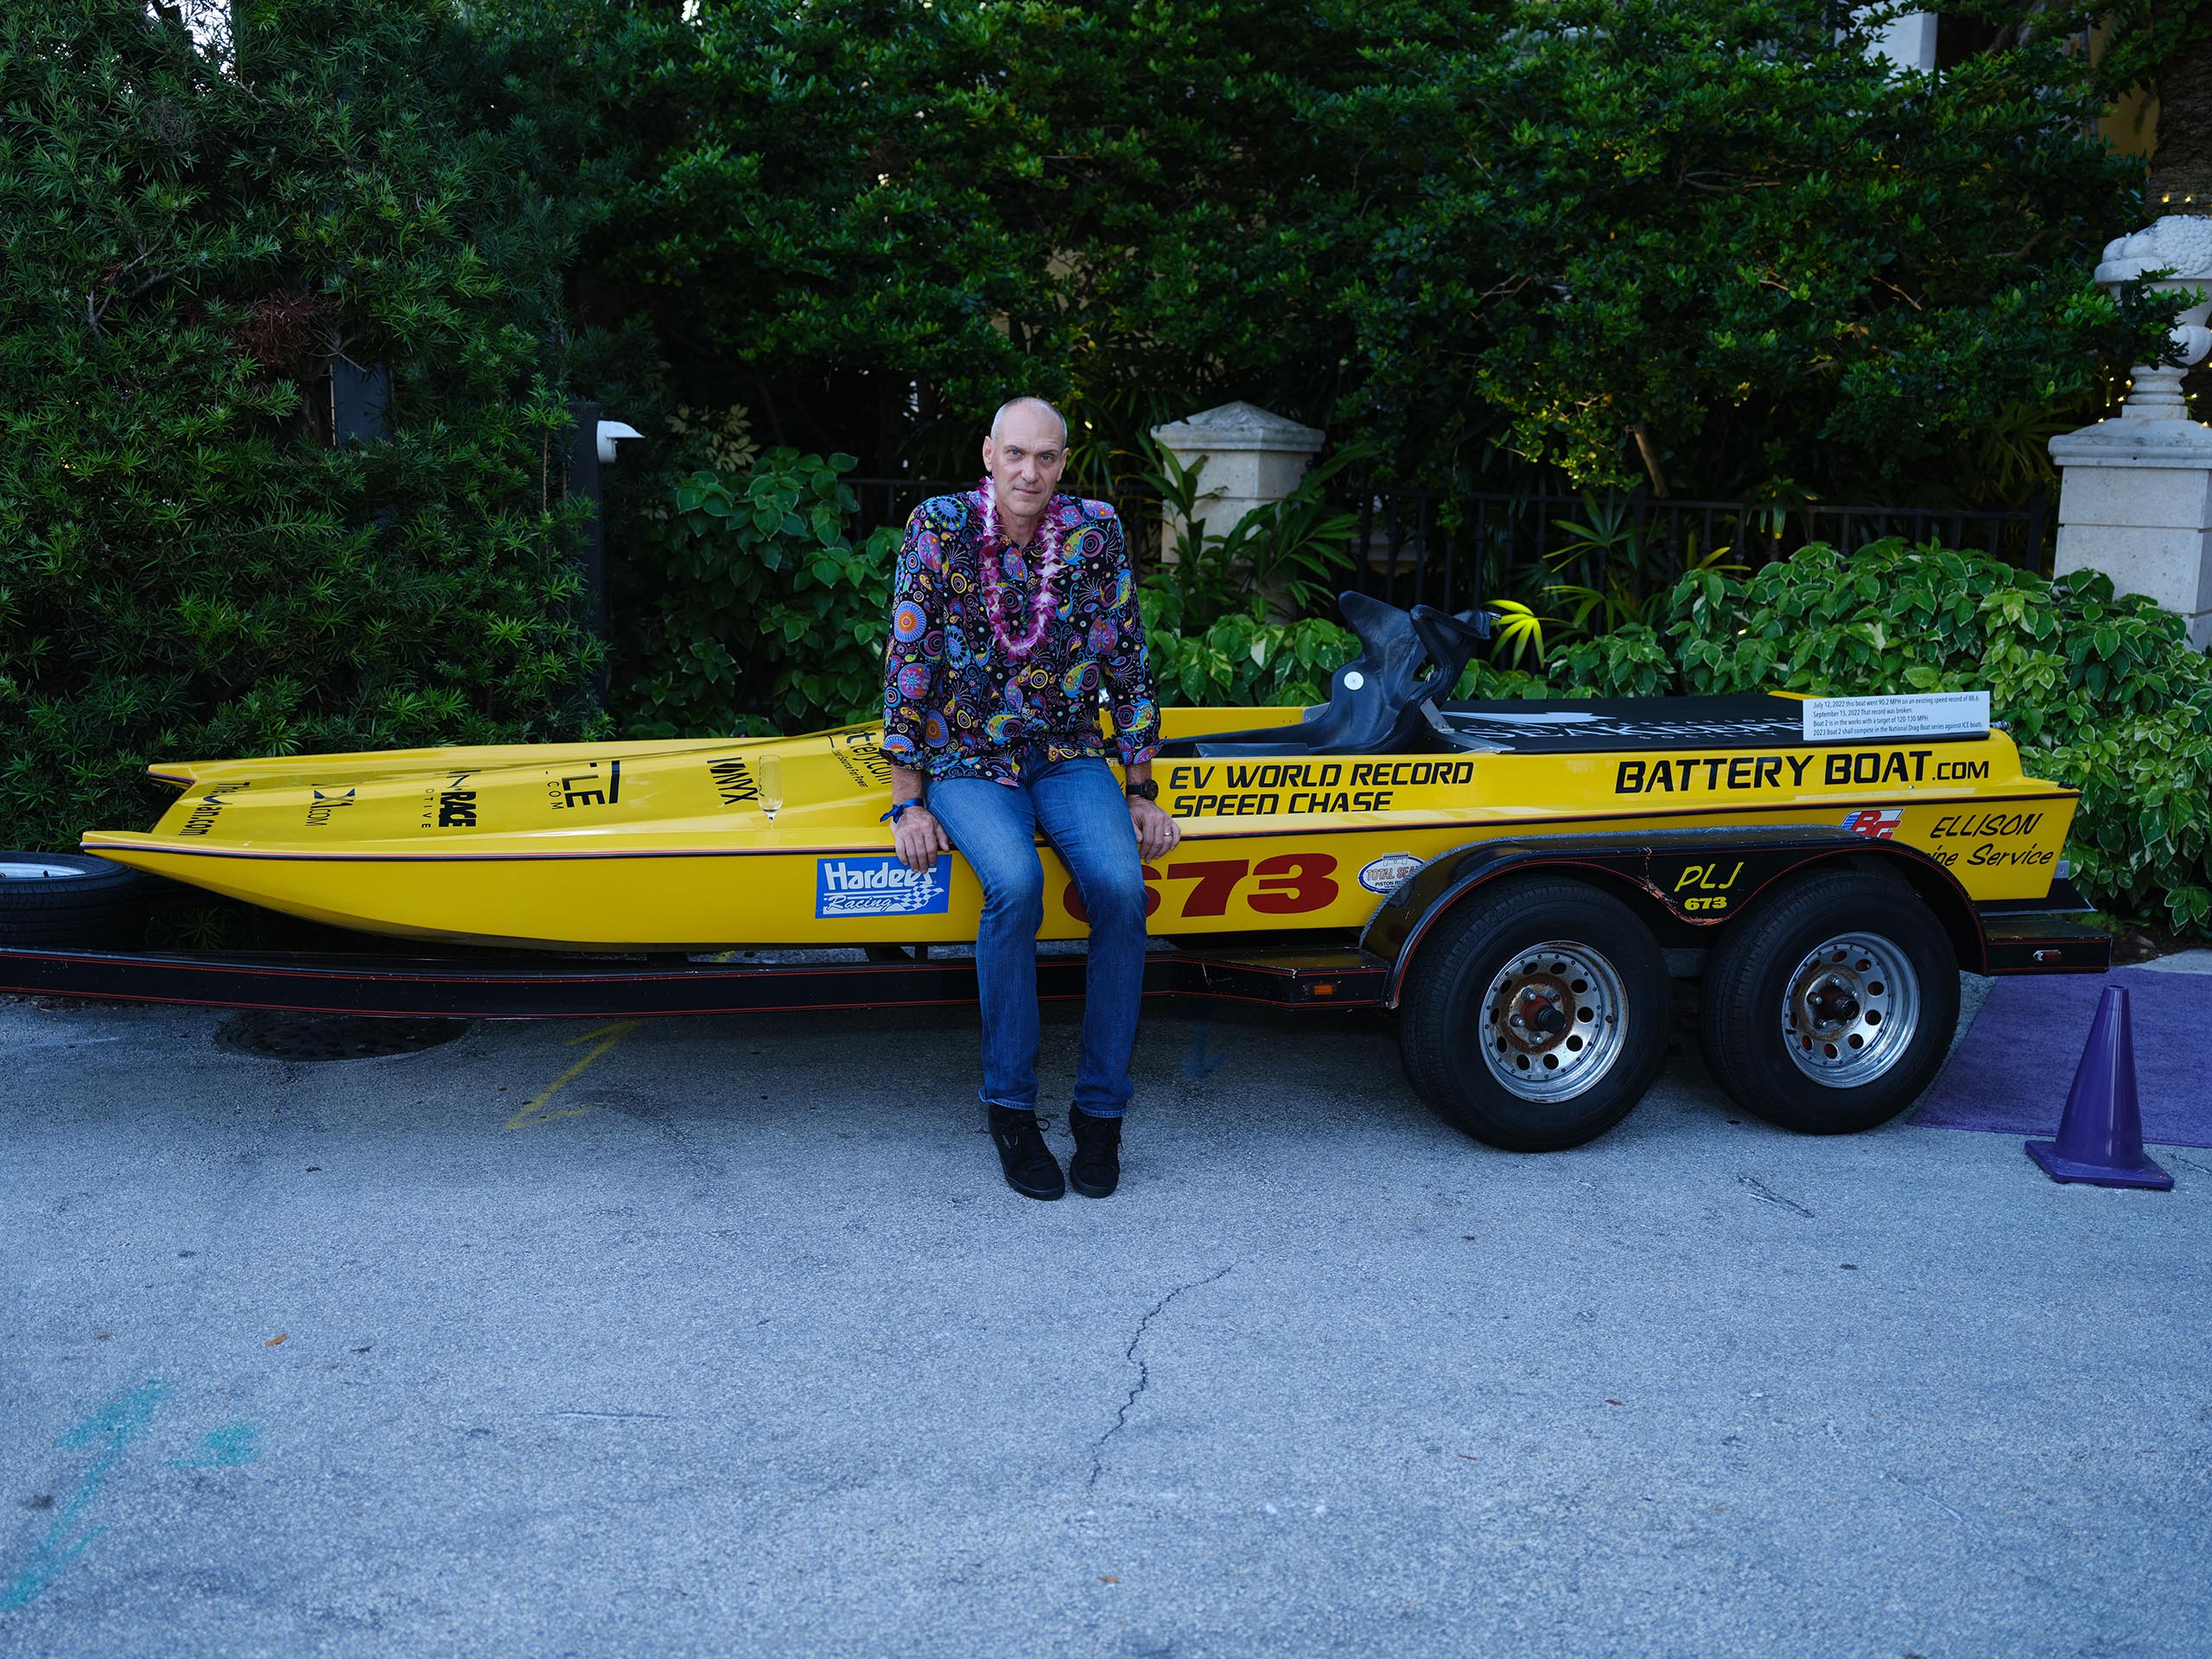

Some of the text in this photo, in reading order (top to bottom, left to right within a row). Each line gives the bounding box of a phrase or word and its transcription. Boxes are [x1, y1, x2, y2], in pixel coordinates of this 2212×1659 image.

[1461, 721, 1803, 739] SEAKEEPE
[1169, 761, 1474, 790] EV WORLD RECORD
[1615, 754, 1815, 793] BATTERY
[1171, 791, 1394, 818] SPEED CHASE
[1929, 813, 2044, 839] ELLISON
[1927, 842, 2054, 866] ine Service
[1366, 866, 1421, 881] TOTAL SEA
[1674, 861, 1745, 892] PLJ
[826, 894, 893, 912] Racing
[1684, 896, 1727, 911] 673
